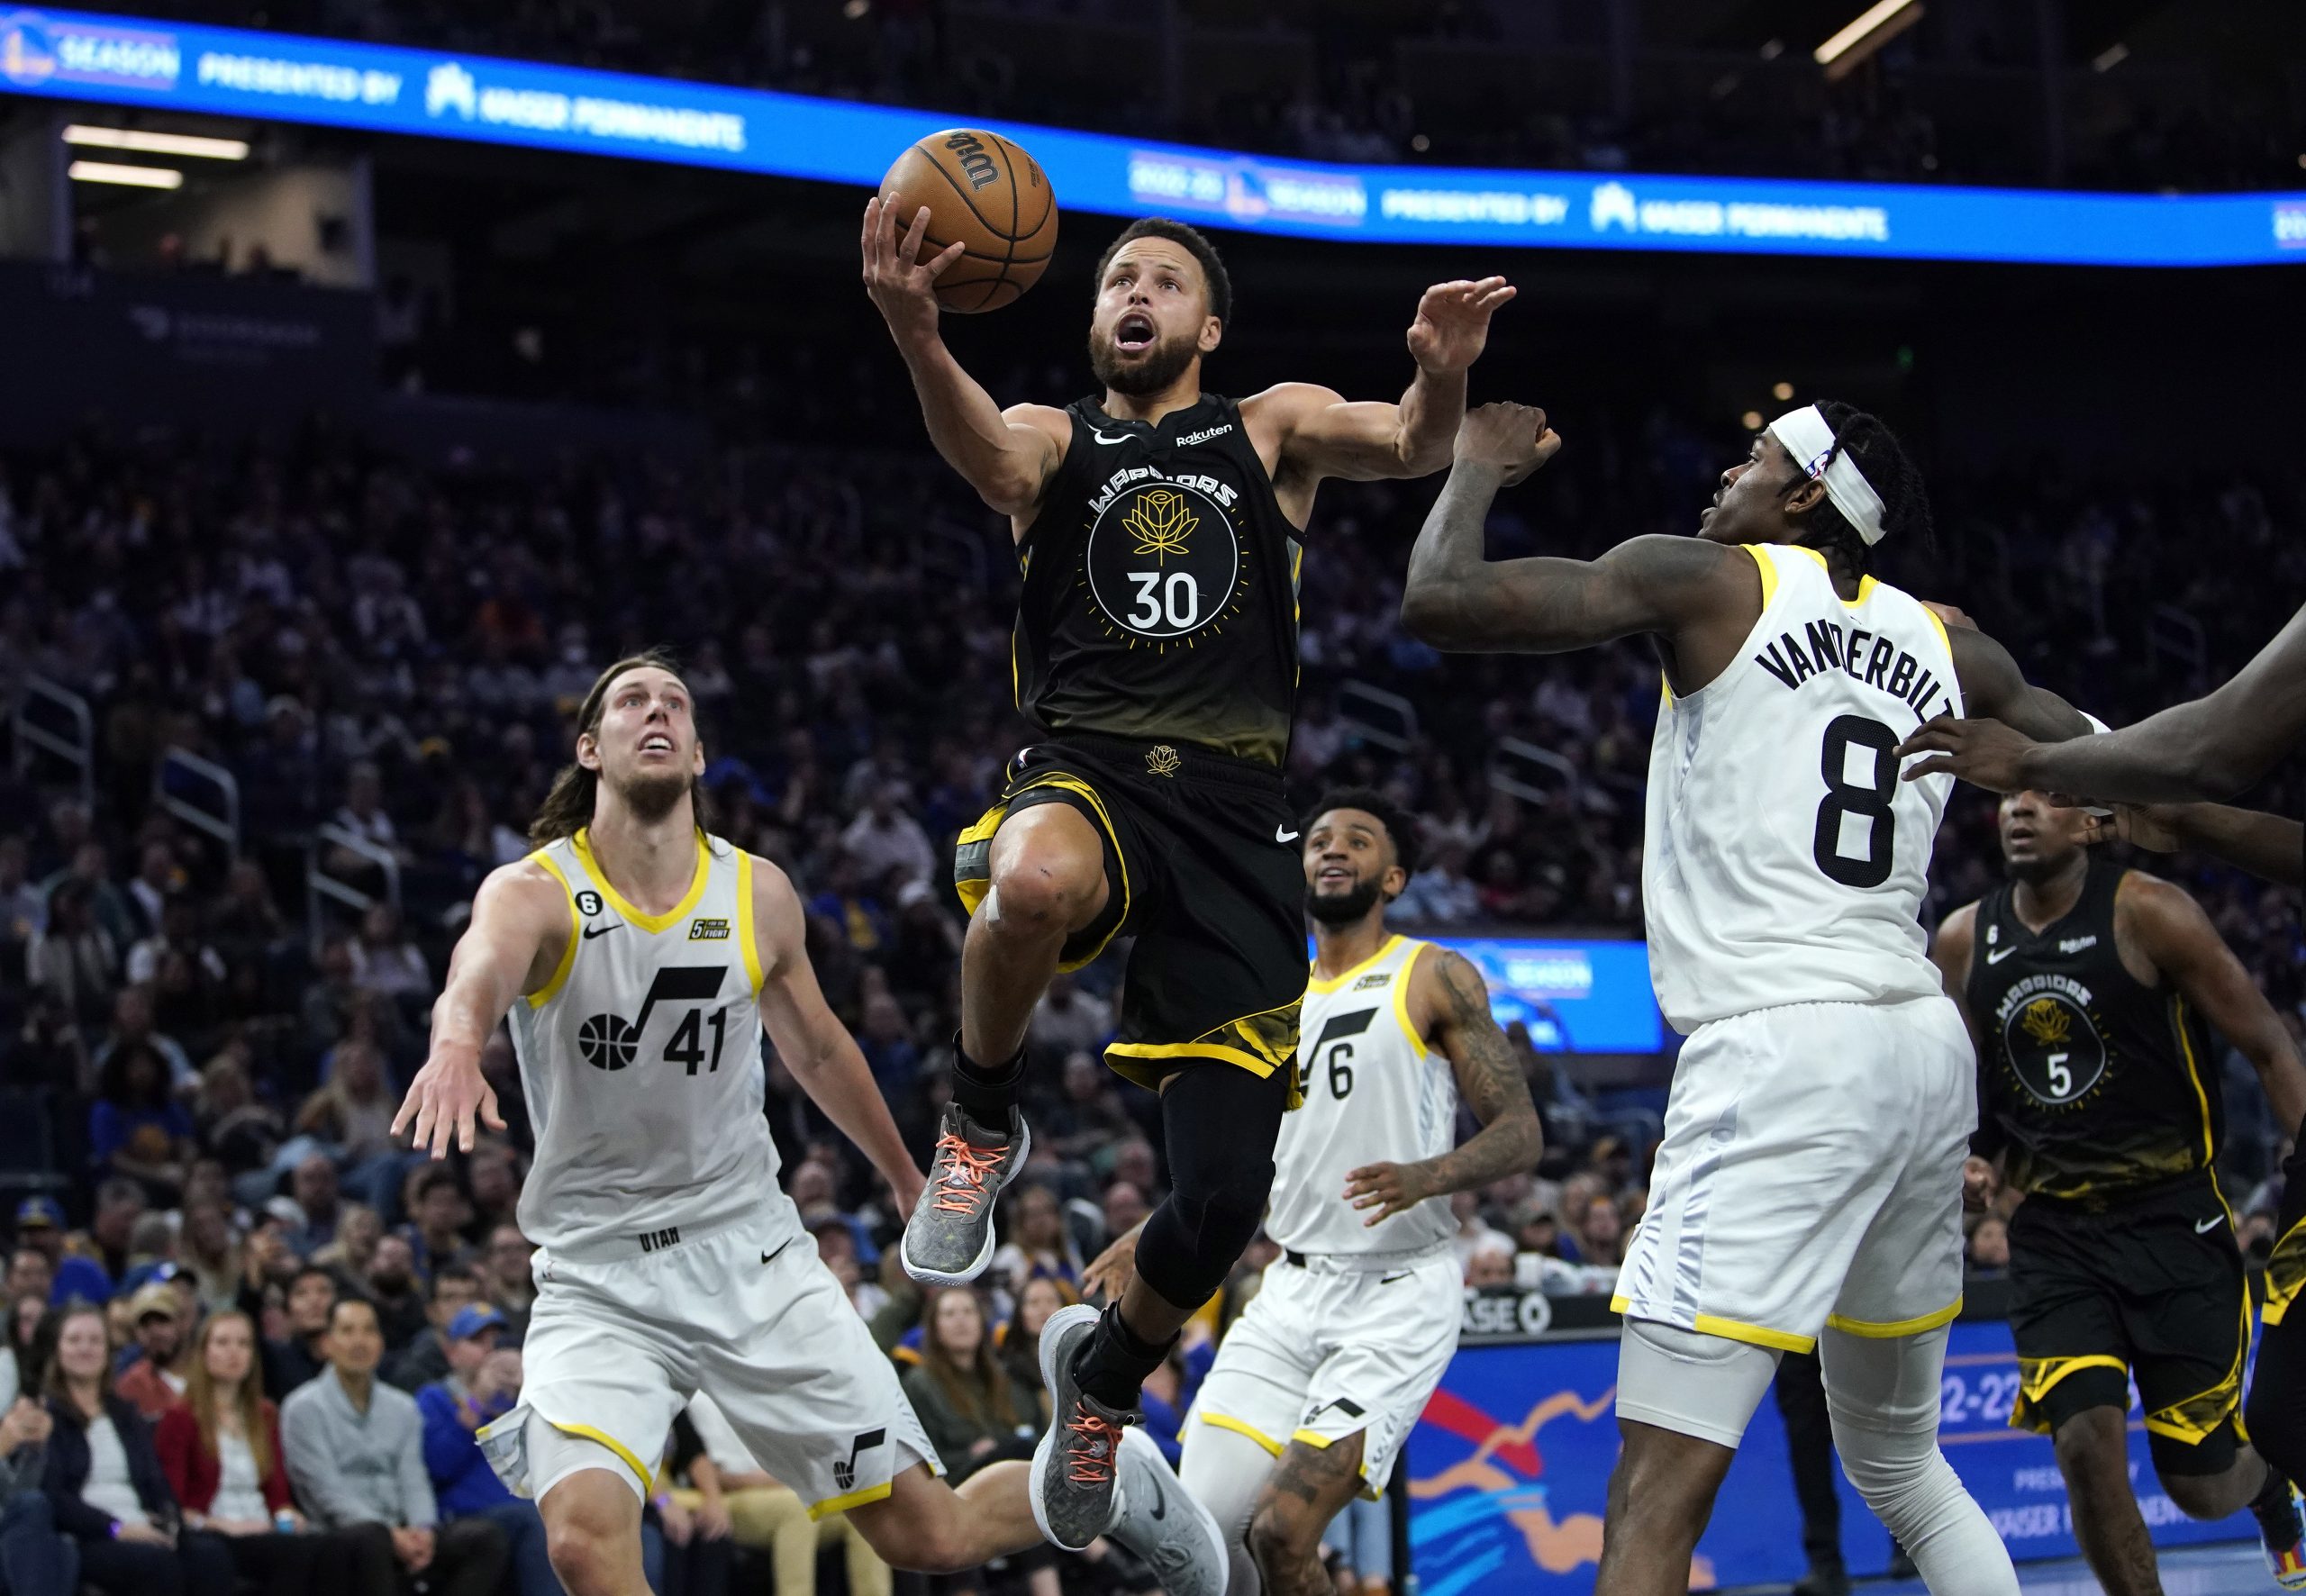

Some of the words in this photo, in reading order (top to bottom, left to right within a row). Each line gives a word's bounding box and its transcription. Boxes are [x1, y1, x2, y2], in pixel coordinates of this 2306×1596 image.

[57, 34, 180, 78] SEASON
[196, 51, 360, 101] PRESENTED
[361, 68, 404, 105] BY
[1381, 188, 1530, 223] PRESENTED
[1531, 192, 1570, 225] BY
[1176, 423, 1232, 448] Rakuten
[1088, 465, 1239, 514] WARRORS
[1126, 571, 1198, 629] 30
[1813, 713, 1901, 888] 8
[580, 893, 597, 914] 6
[692, 920, 704, 939] 5
[704, 929, 728, 939] FIGHT
[1986, 924, 1999, 945] 6
[1995, 974, 2092, 1020] WARRIORS
[663, 1006, 728, 1076] 41
[1329, 1043, 1355, 1101] 6
[2047, 1052, 2072, 1097] 5
[639, 1226, 680, 1253] UTAH
